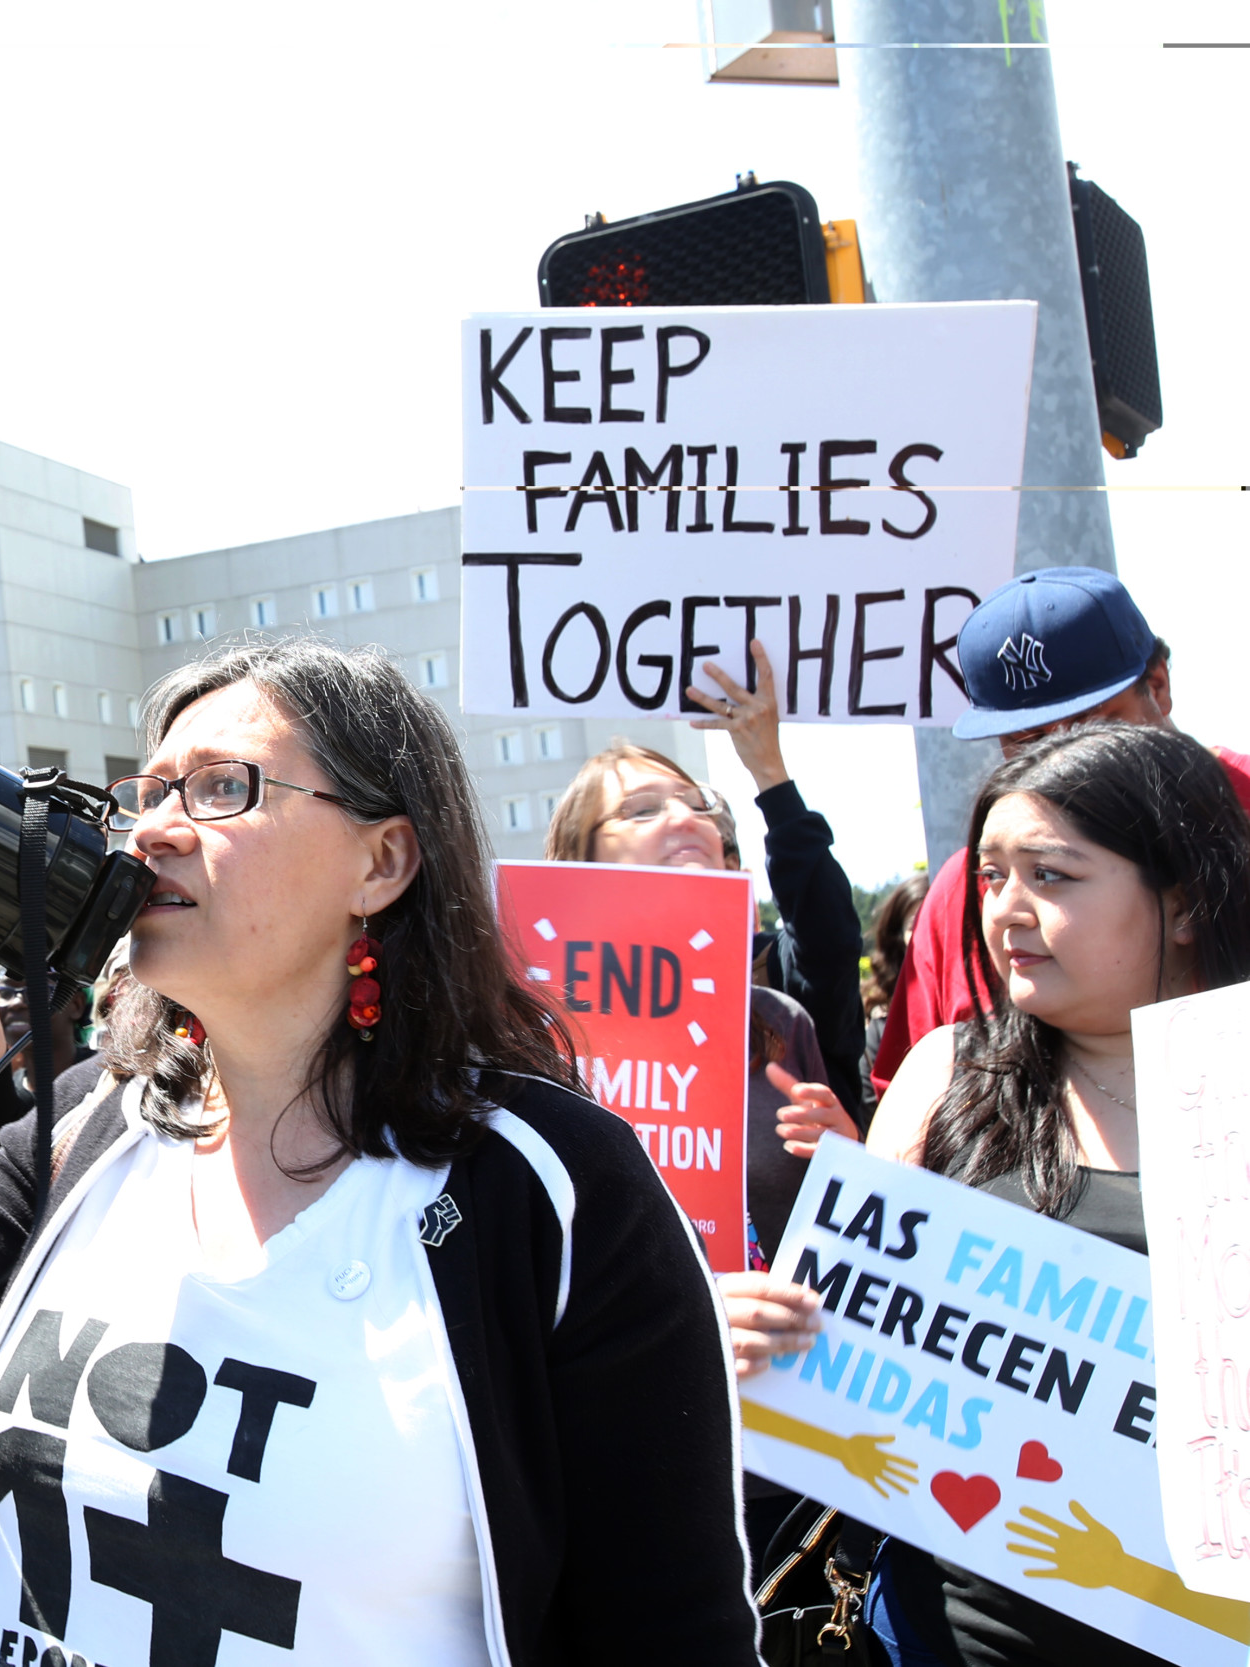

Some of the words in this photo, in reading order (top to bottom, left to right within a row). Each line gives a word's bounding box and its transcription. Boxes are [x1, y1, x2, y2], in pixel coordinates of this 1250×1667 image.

[479, 325, 710, 424] KEEP
[523, 440, 943, 540] FAMILIES
[462, 552, 982, 718] TOGETHER
[565, 940, 681, 1018] END
[814, 1177, 932, 1260] LAS
[945, 1228, 1156, 1365] FAMIL
[792, 1246, 1096, 1416] MERECEN
[1112, 1379, 1158, 1449] E
